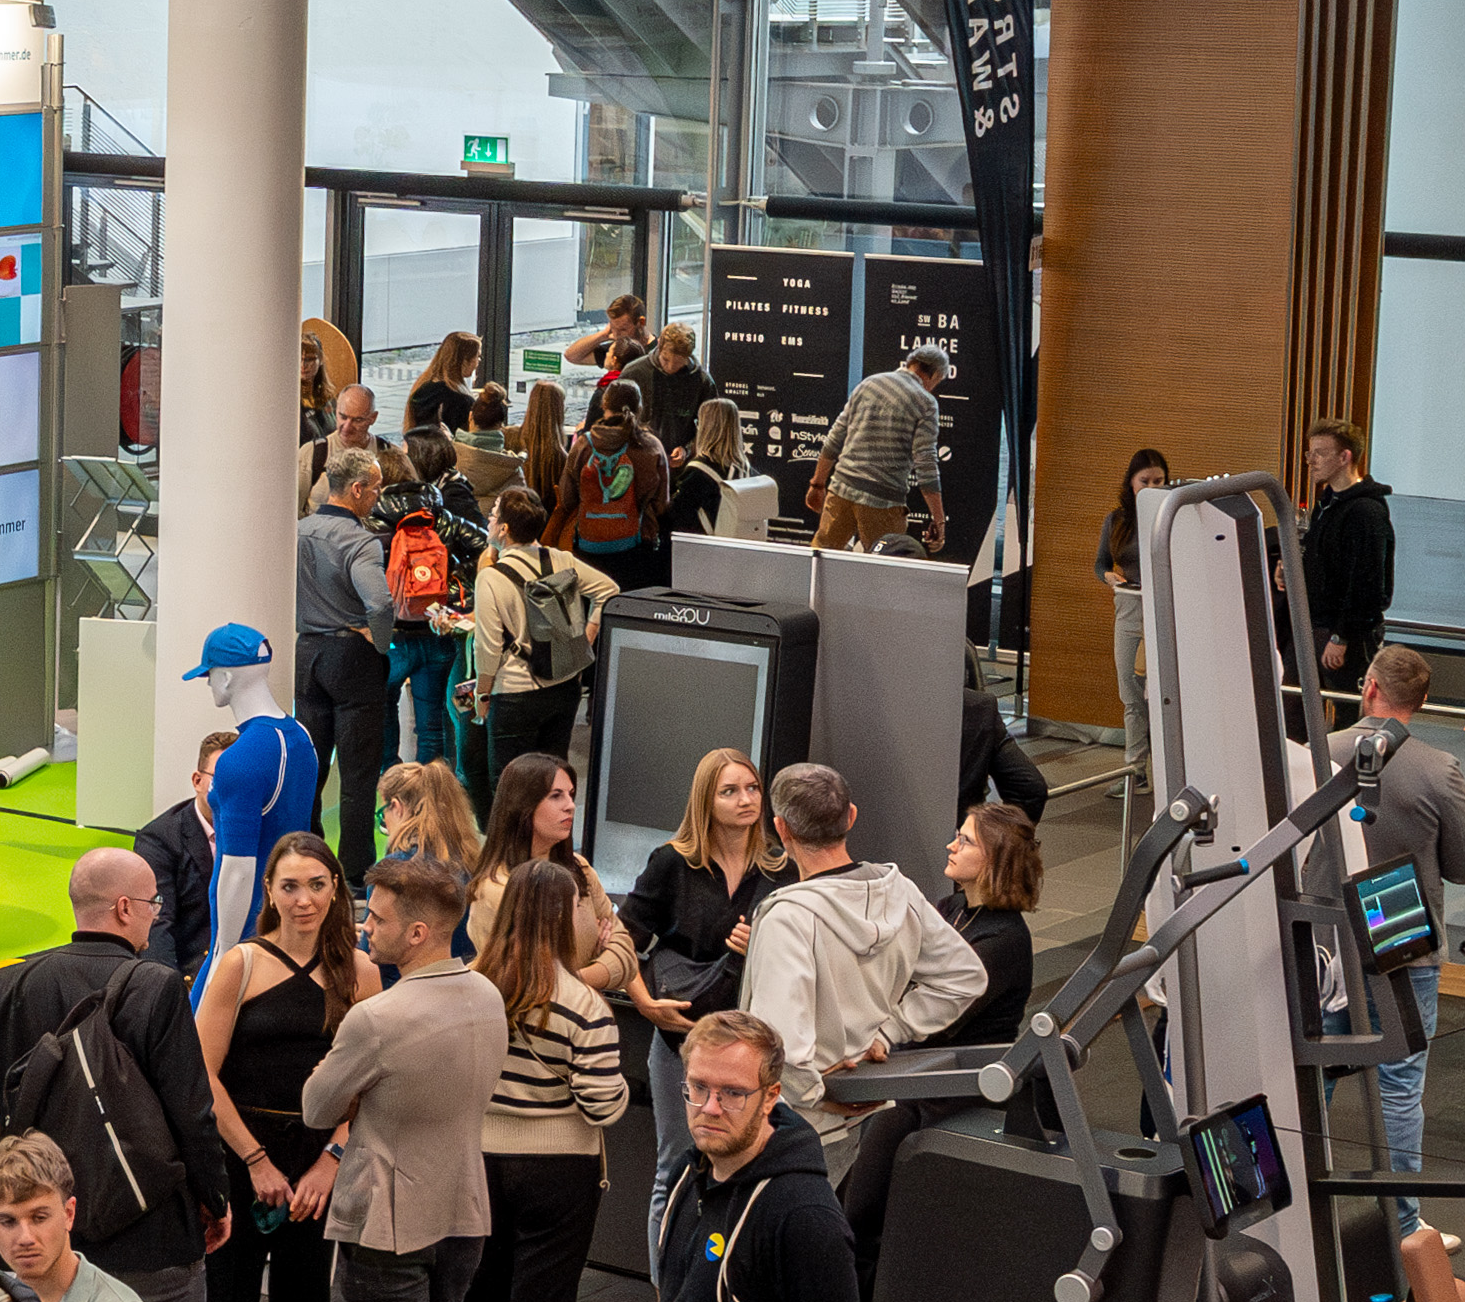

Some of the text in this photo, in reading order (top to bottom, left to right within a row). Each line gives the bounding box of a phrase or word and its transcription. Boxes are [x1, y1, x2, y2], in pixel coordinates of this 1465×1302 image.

[782, 278, 811, 288] YOGA
[726, 300, 829, 316] PILATES FITNESS
[937, 313, 959, 330] BA
[724, 331, 803, 346] PHYSIO EMS
